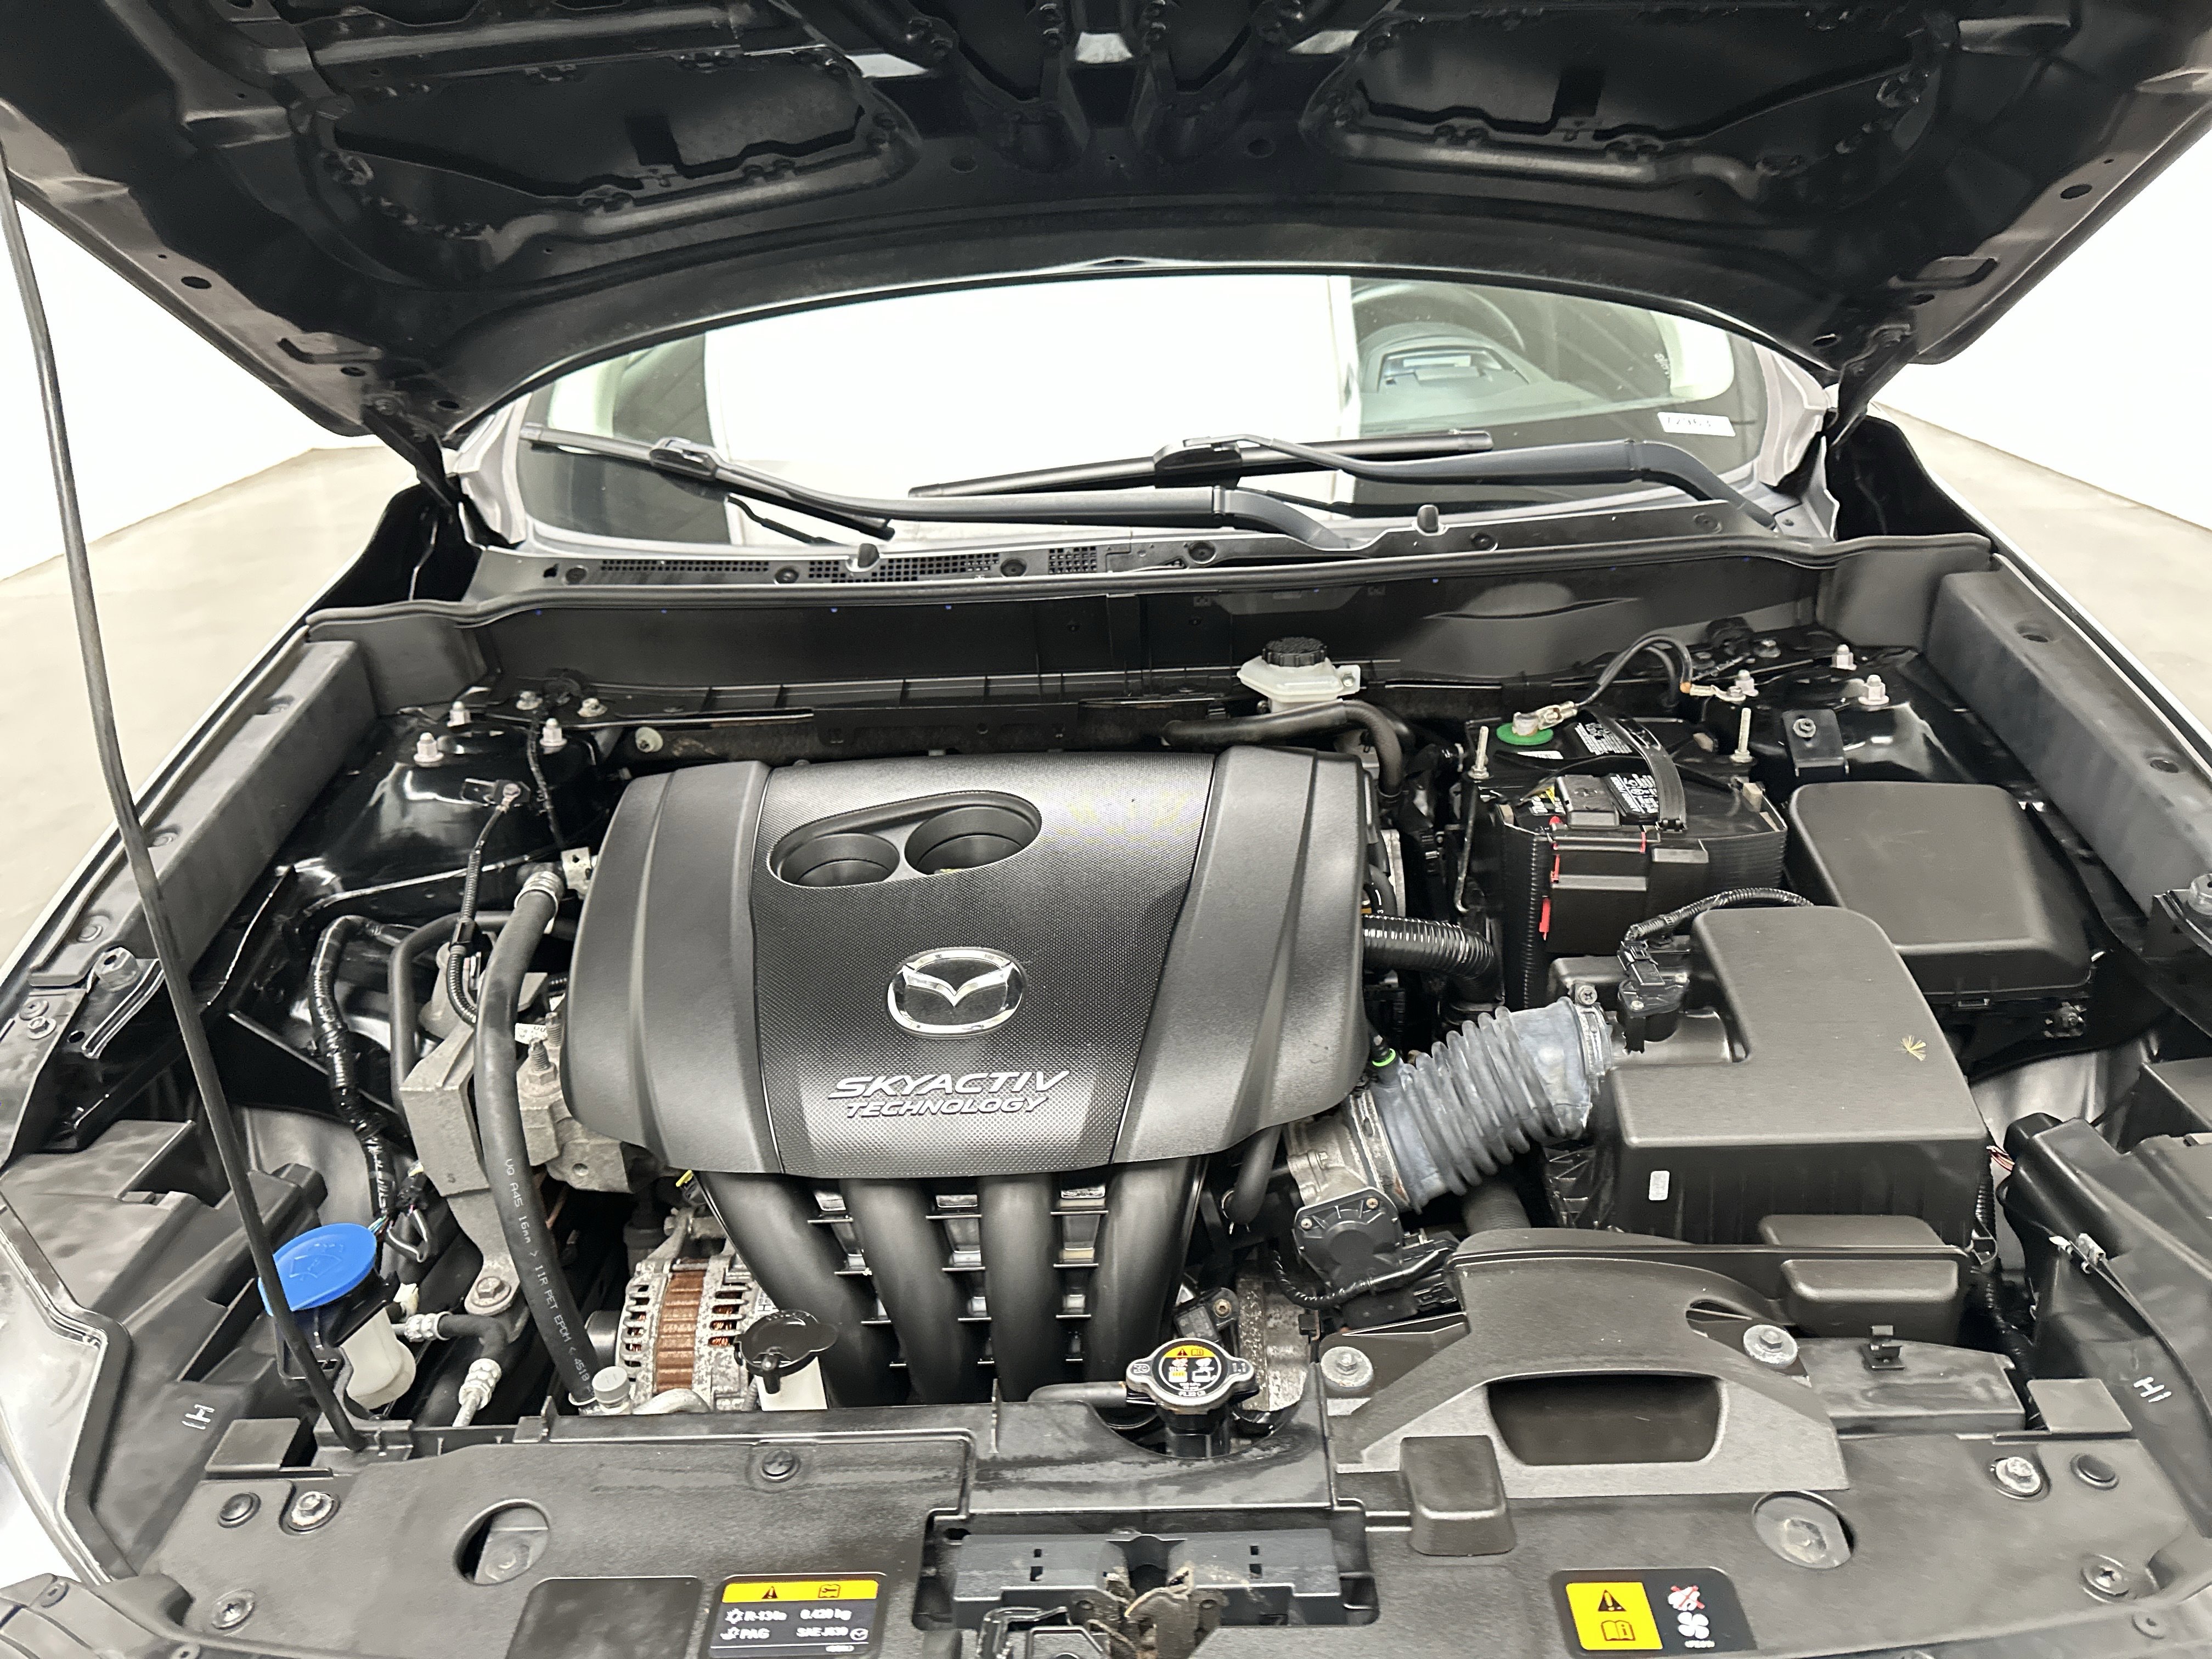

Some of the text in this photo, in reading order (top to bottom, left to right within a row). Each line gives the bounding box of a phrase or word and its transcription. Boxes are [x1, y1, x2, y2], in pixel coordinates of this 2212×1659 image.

[827, 1070, 1070, 1099] SKYACTIV
[847, 1097, 1049, 1118] TECHNOLOGY
[544, 1289, 558, 1309] PET
[554, 1314, 572, 1342] EPDM
[574, 1358, 590, 1381] 4518
[740, 1628, 770, 1639] PAG
